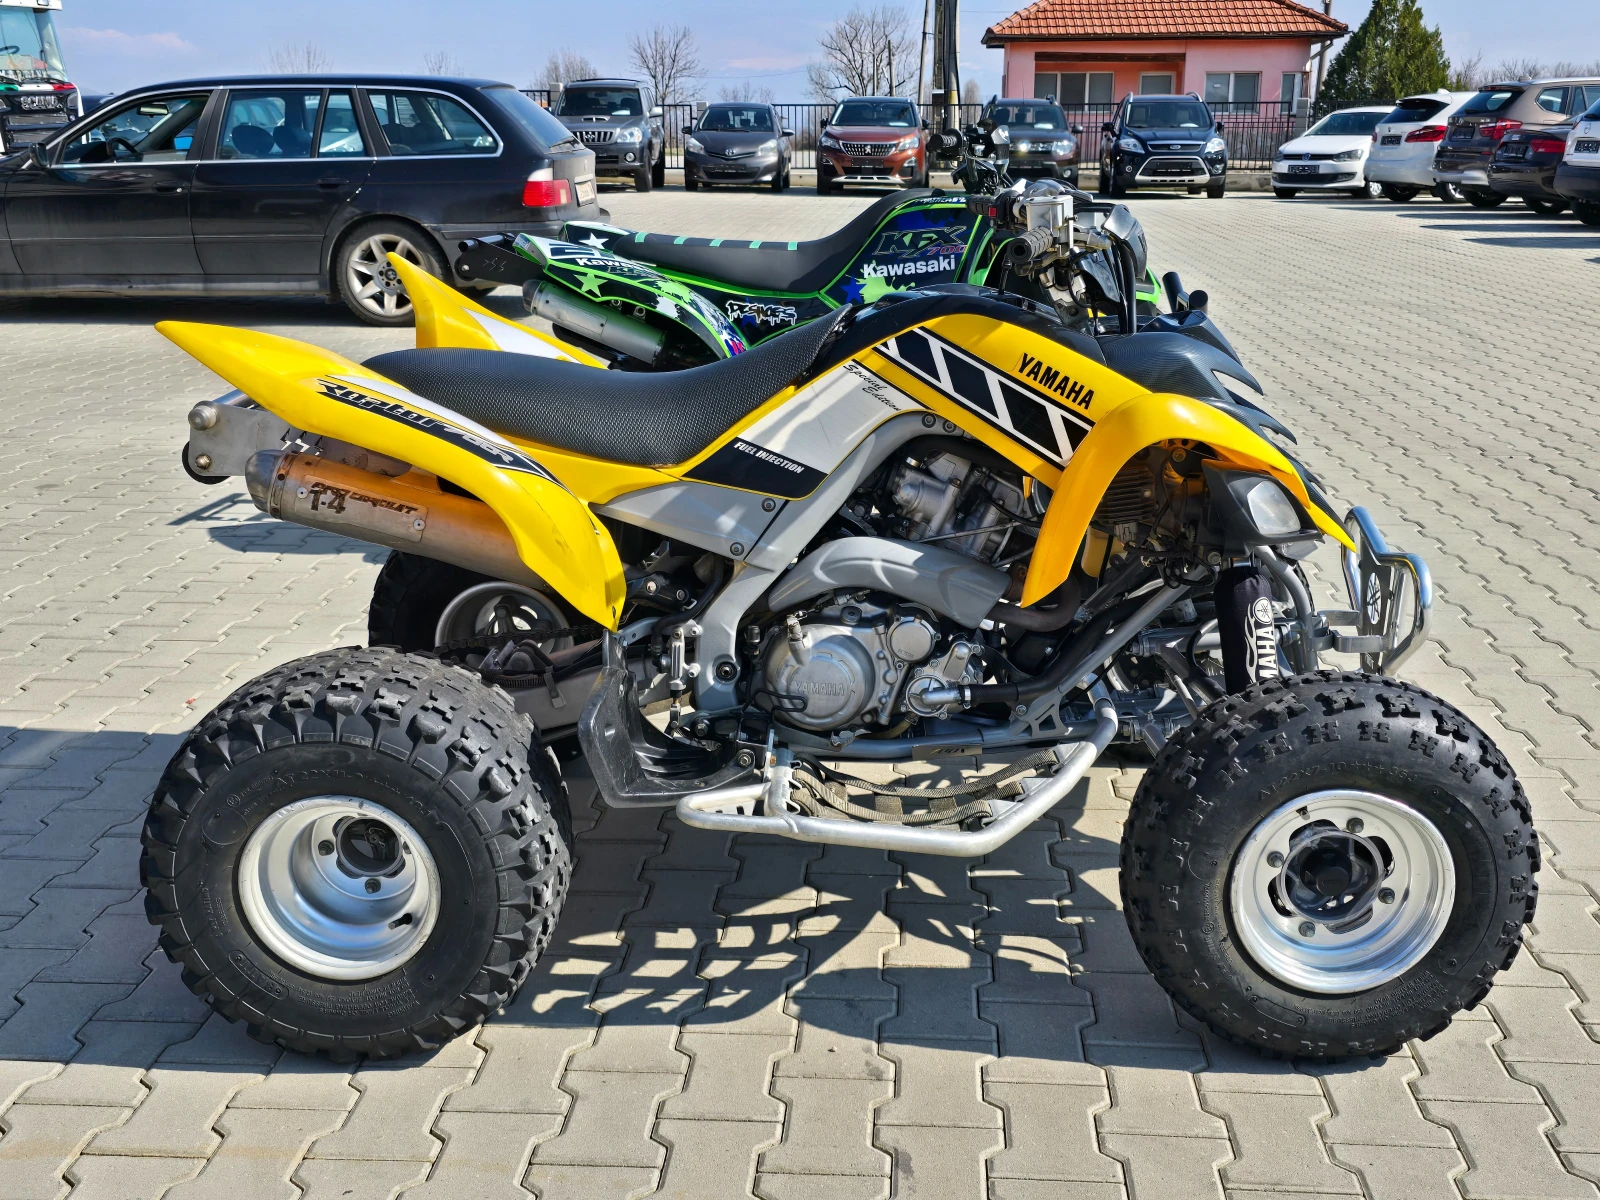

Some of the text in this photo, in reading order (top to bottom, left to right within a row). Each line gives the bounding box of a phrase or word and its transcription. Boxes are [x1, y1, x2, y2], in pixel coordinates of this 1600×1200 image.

[872, 226, 967, 259] KFX
[926, 245, 967, 256] 700
[863, 254, 956, 279] Kawasaki
[842, 363, 888, 392] Special
[1018, 352, 1095, 410] YAMAHA
[862, 385, 902, 411] Edition
[733, 441, 805, 474] FUEL INJECTION
[795, 682, 845, 696] YAMAHA
